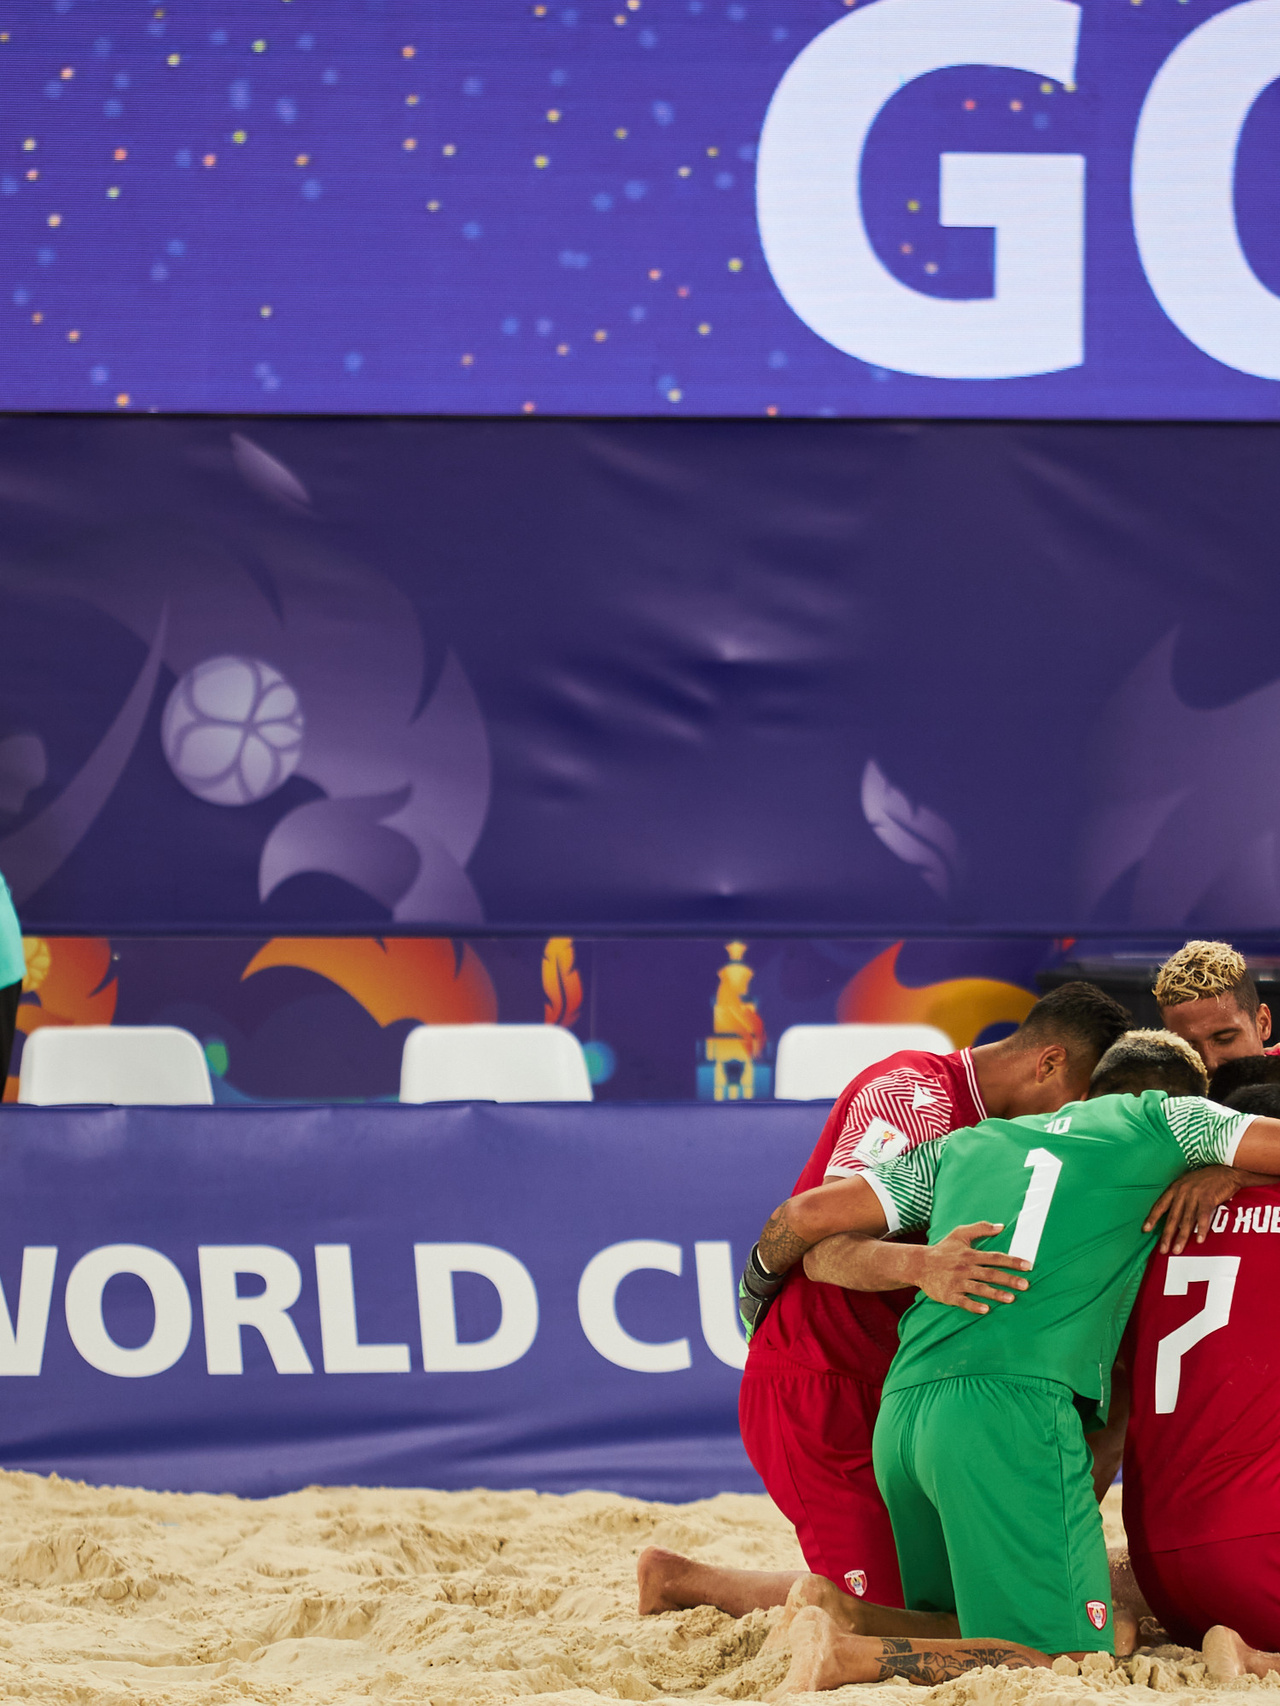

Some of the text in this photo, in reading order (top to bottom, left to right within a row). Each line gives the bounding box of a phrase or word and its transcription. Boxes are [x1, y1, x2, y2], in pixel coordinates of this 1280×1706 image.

[1008, 1147, 1063, 1271] 1
[577, 1239, 750, 1373] CU
[1155, 1256, 1241, 1414] 7
